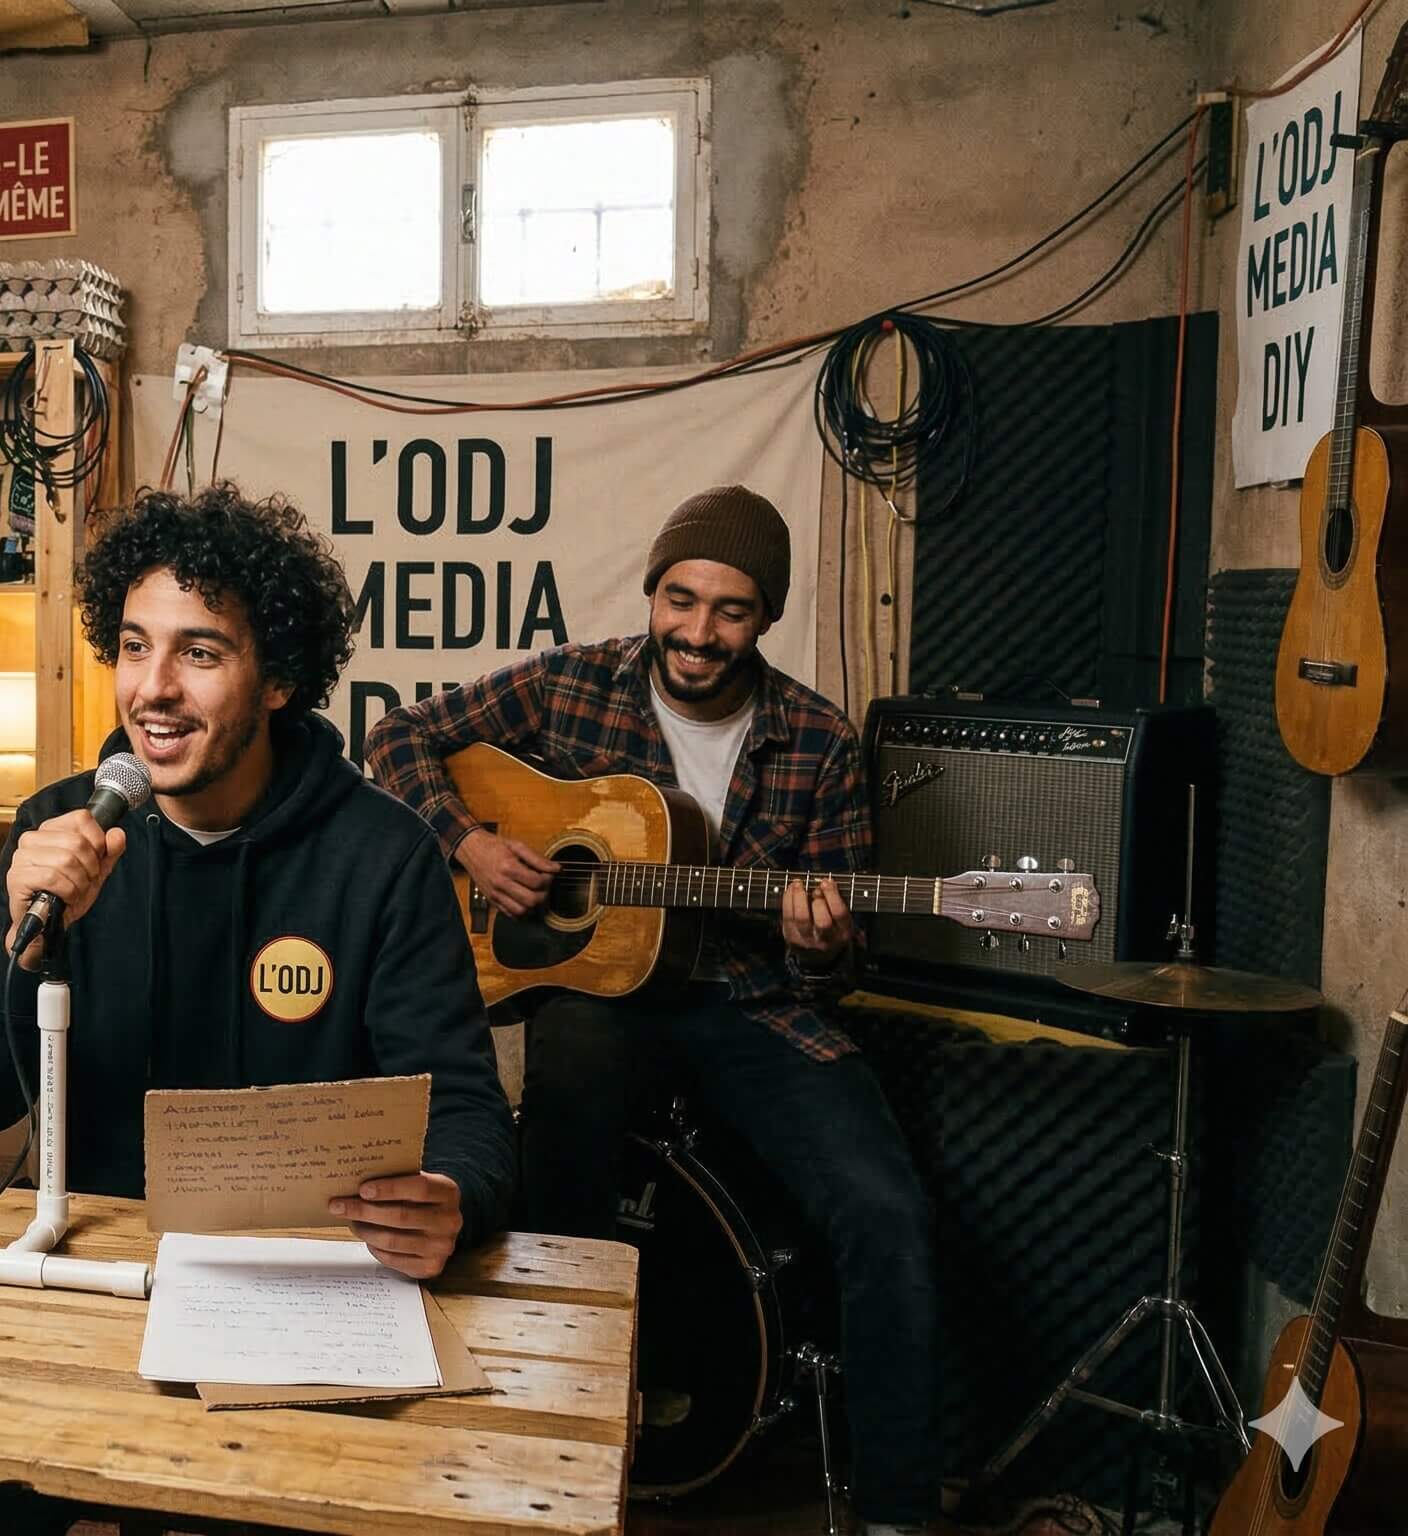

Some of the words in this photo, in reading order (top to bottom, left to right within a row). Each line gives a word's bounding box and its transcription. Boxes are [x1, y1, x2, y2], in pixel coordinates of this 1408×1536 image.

[1253, 90, 1342, 223] L'ODJ
[1247, 203, 1338, 318] MEDIA
[1262, 325, 1315, 432] DIY
[331, 436, 553, 536] L'ODJ
[259, 963, 324, 996] L'ODJ
